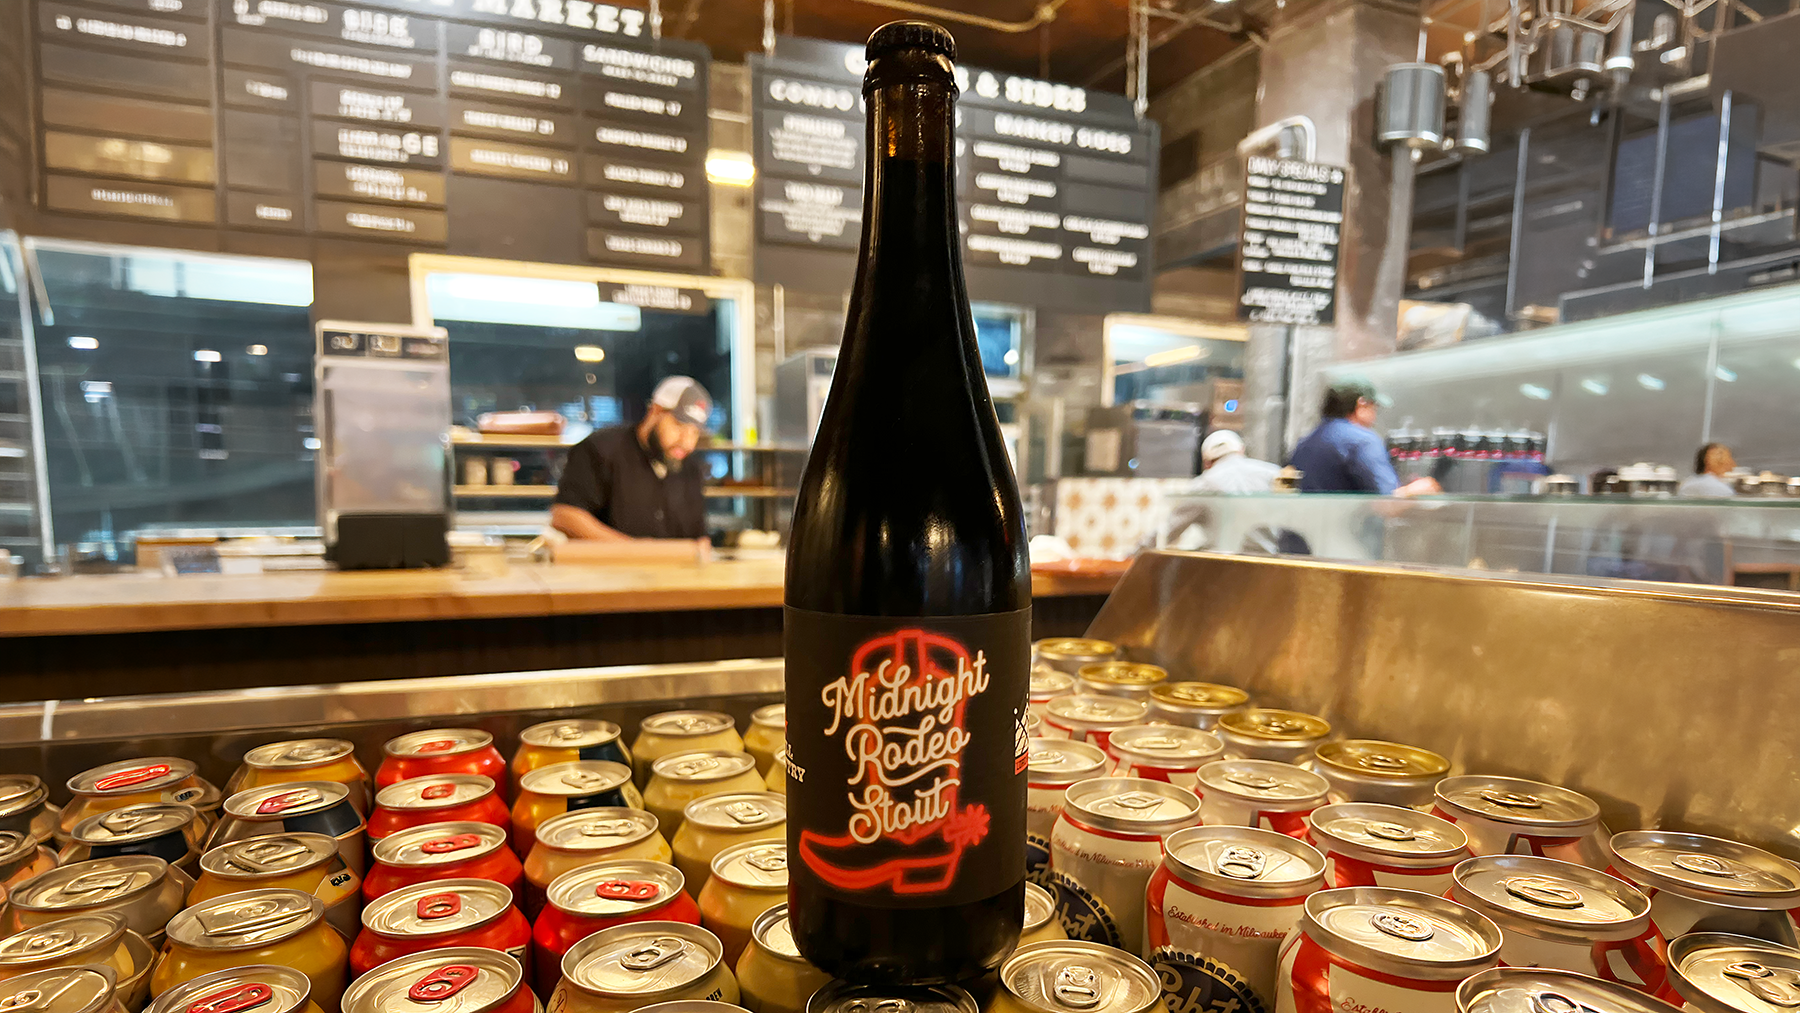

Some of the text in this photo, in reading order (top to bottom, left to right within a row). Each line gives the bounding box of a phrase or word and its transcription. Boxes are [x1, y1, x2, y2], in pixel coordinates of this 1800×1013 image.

[1005, 76, 1087, 113] SIDES
[822, 650, 990, 735] Midnight
[845, 715, 971, 786] Rodeo
[848, 778, 960, 844] Stout
[1167, 905, 1219, 931] Established
[1220, 924, 1232, 935] in
